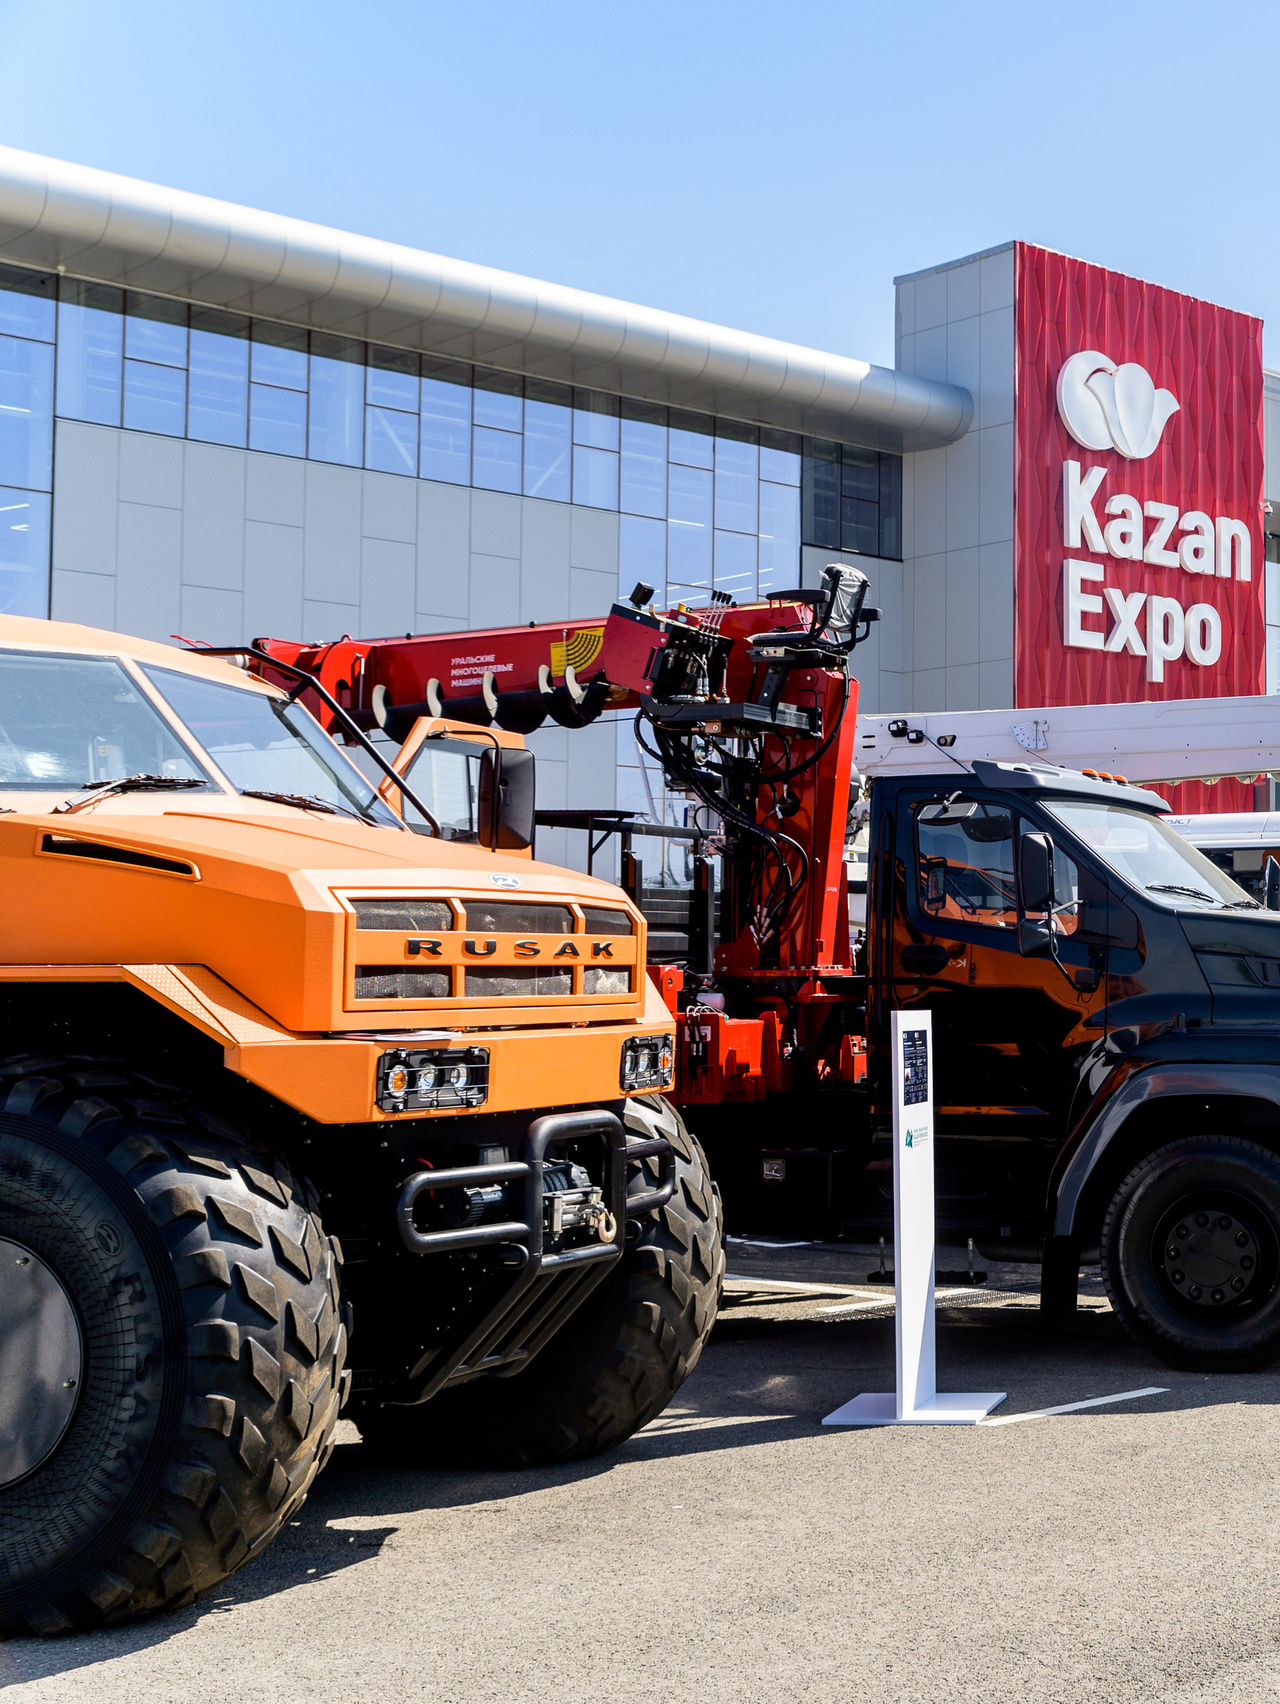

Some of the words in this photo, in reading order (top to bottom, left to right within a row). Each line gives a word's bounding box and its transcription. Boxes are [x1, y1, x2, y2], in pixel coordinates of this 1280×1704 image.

[1063, 459, 1251, 582] Kazan
[1063, 558, 1222, 683] Expo
[451, 654, 496, 666] УРАЛЬСКИЕ
[451, 663, 514, 677] МНОГОЦЕЛЕВЫЕ
[451, 677, 484, 688] МАШИН
[404, 937, 614, 959] RUSAK
